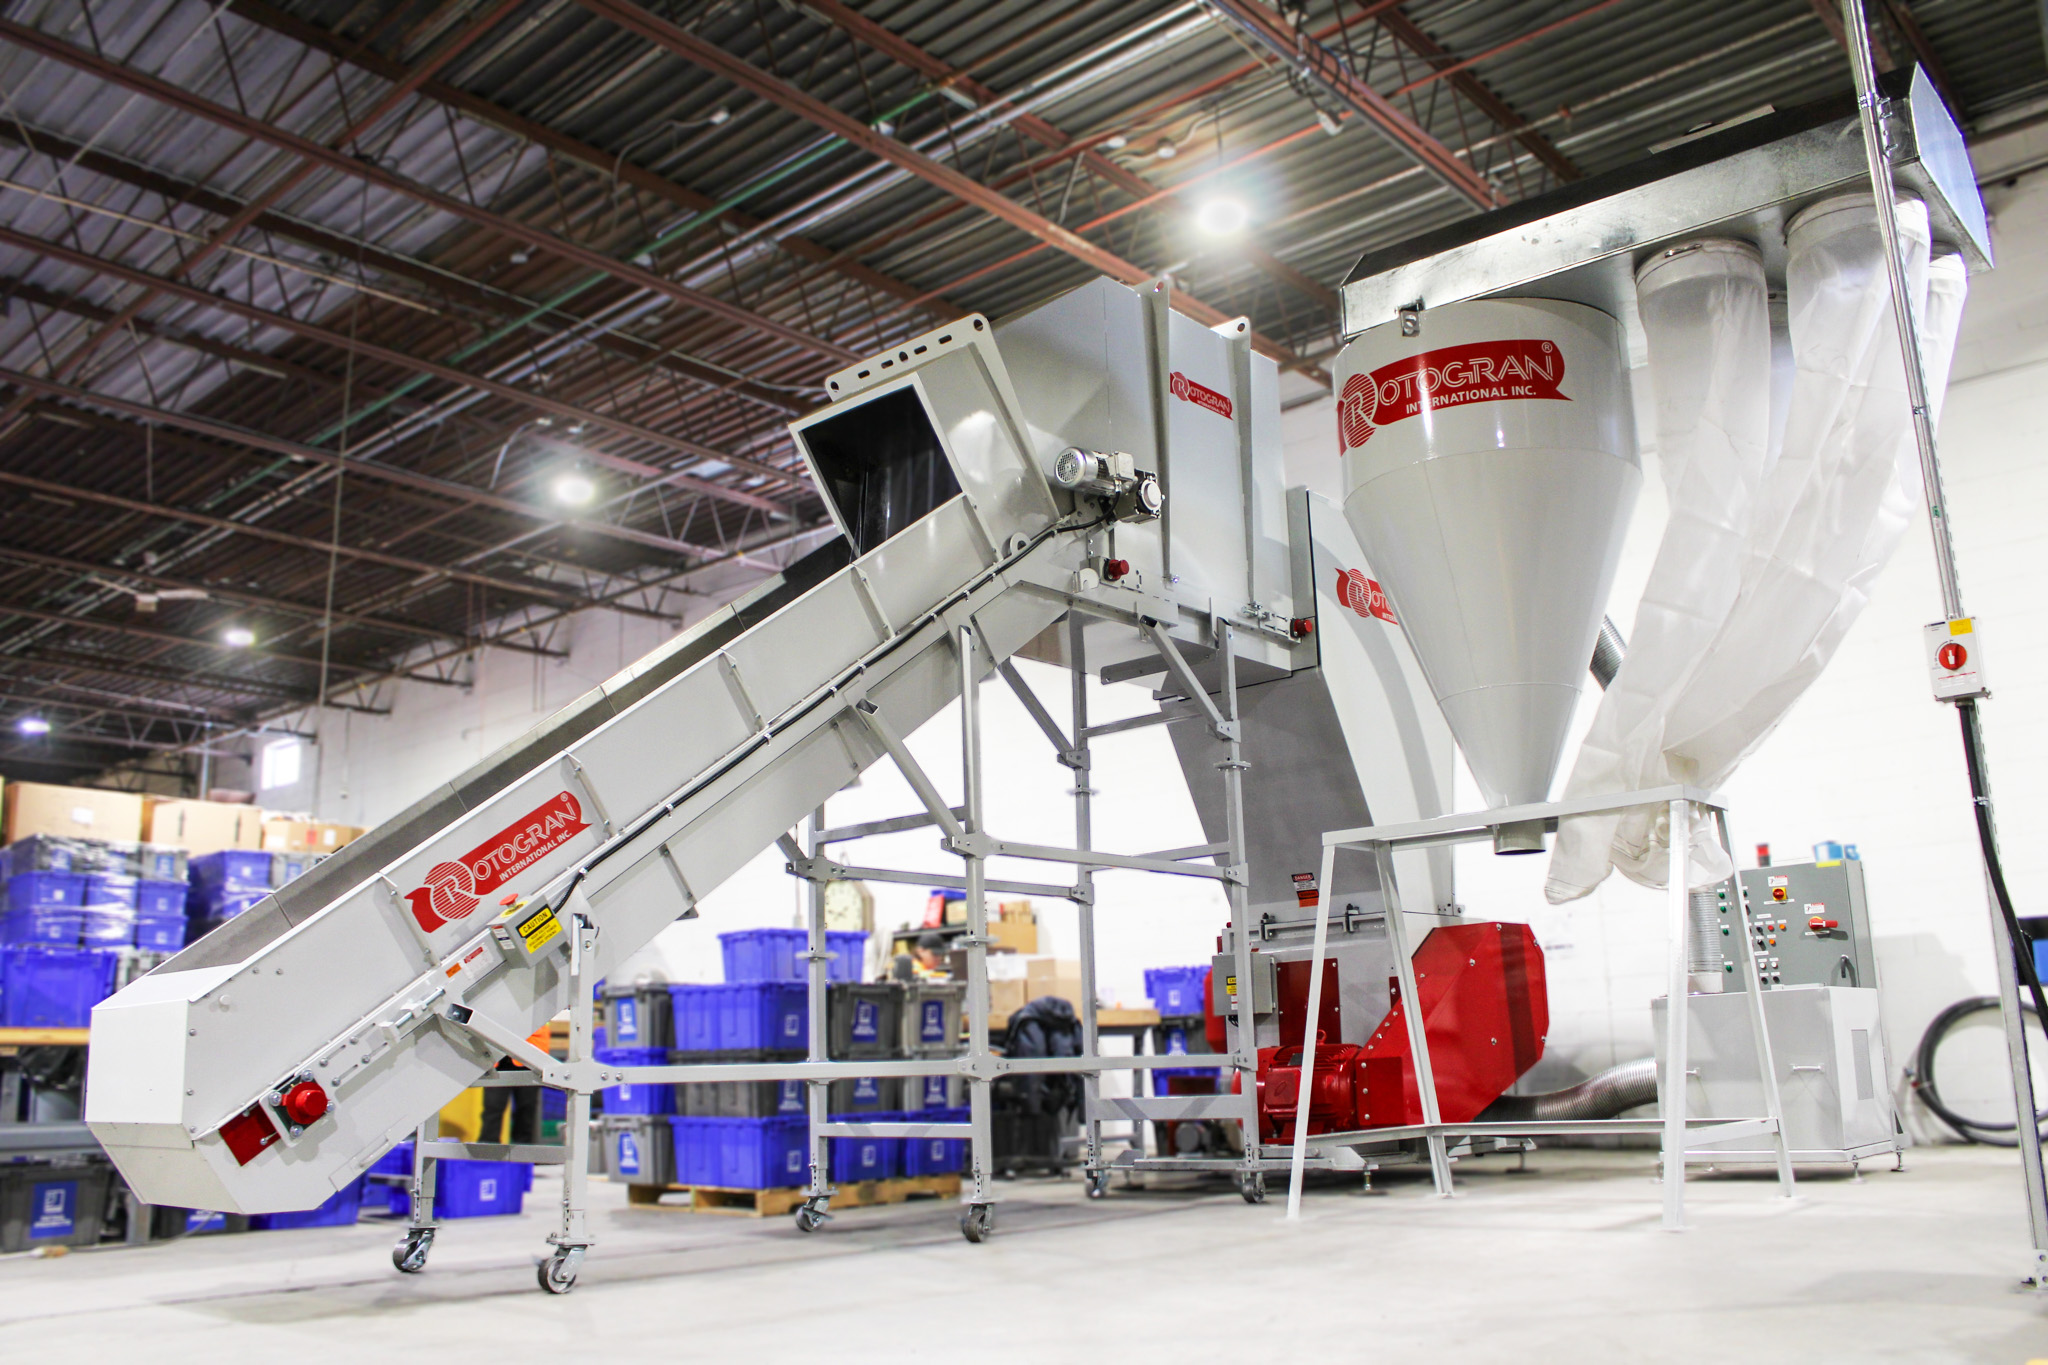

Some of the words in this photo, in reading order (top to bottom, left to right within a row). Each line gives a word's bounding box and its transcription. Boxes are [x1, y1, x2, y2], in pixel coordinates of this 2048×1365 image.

[1511, 385, 1537, 396] INC.
[499, 840, 558, 882] INTERNATIONAL
[557, 829, 573, 843] INC.
[522, 911, 548, 933] CAUTION
